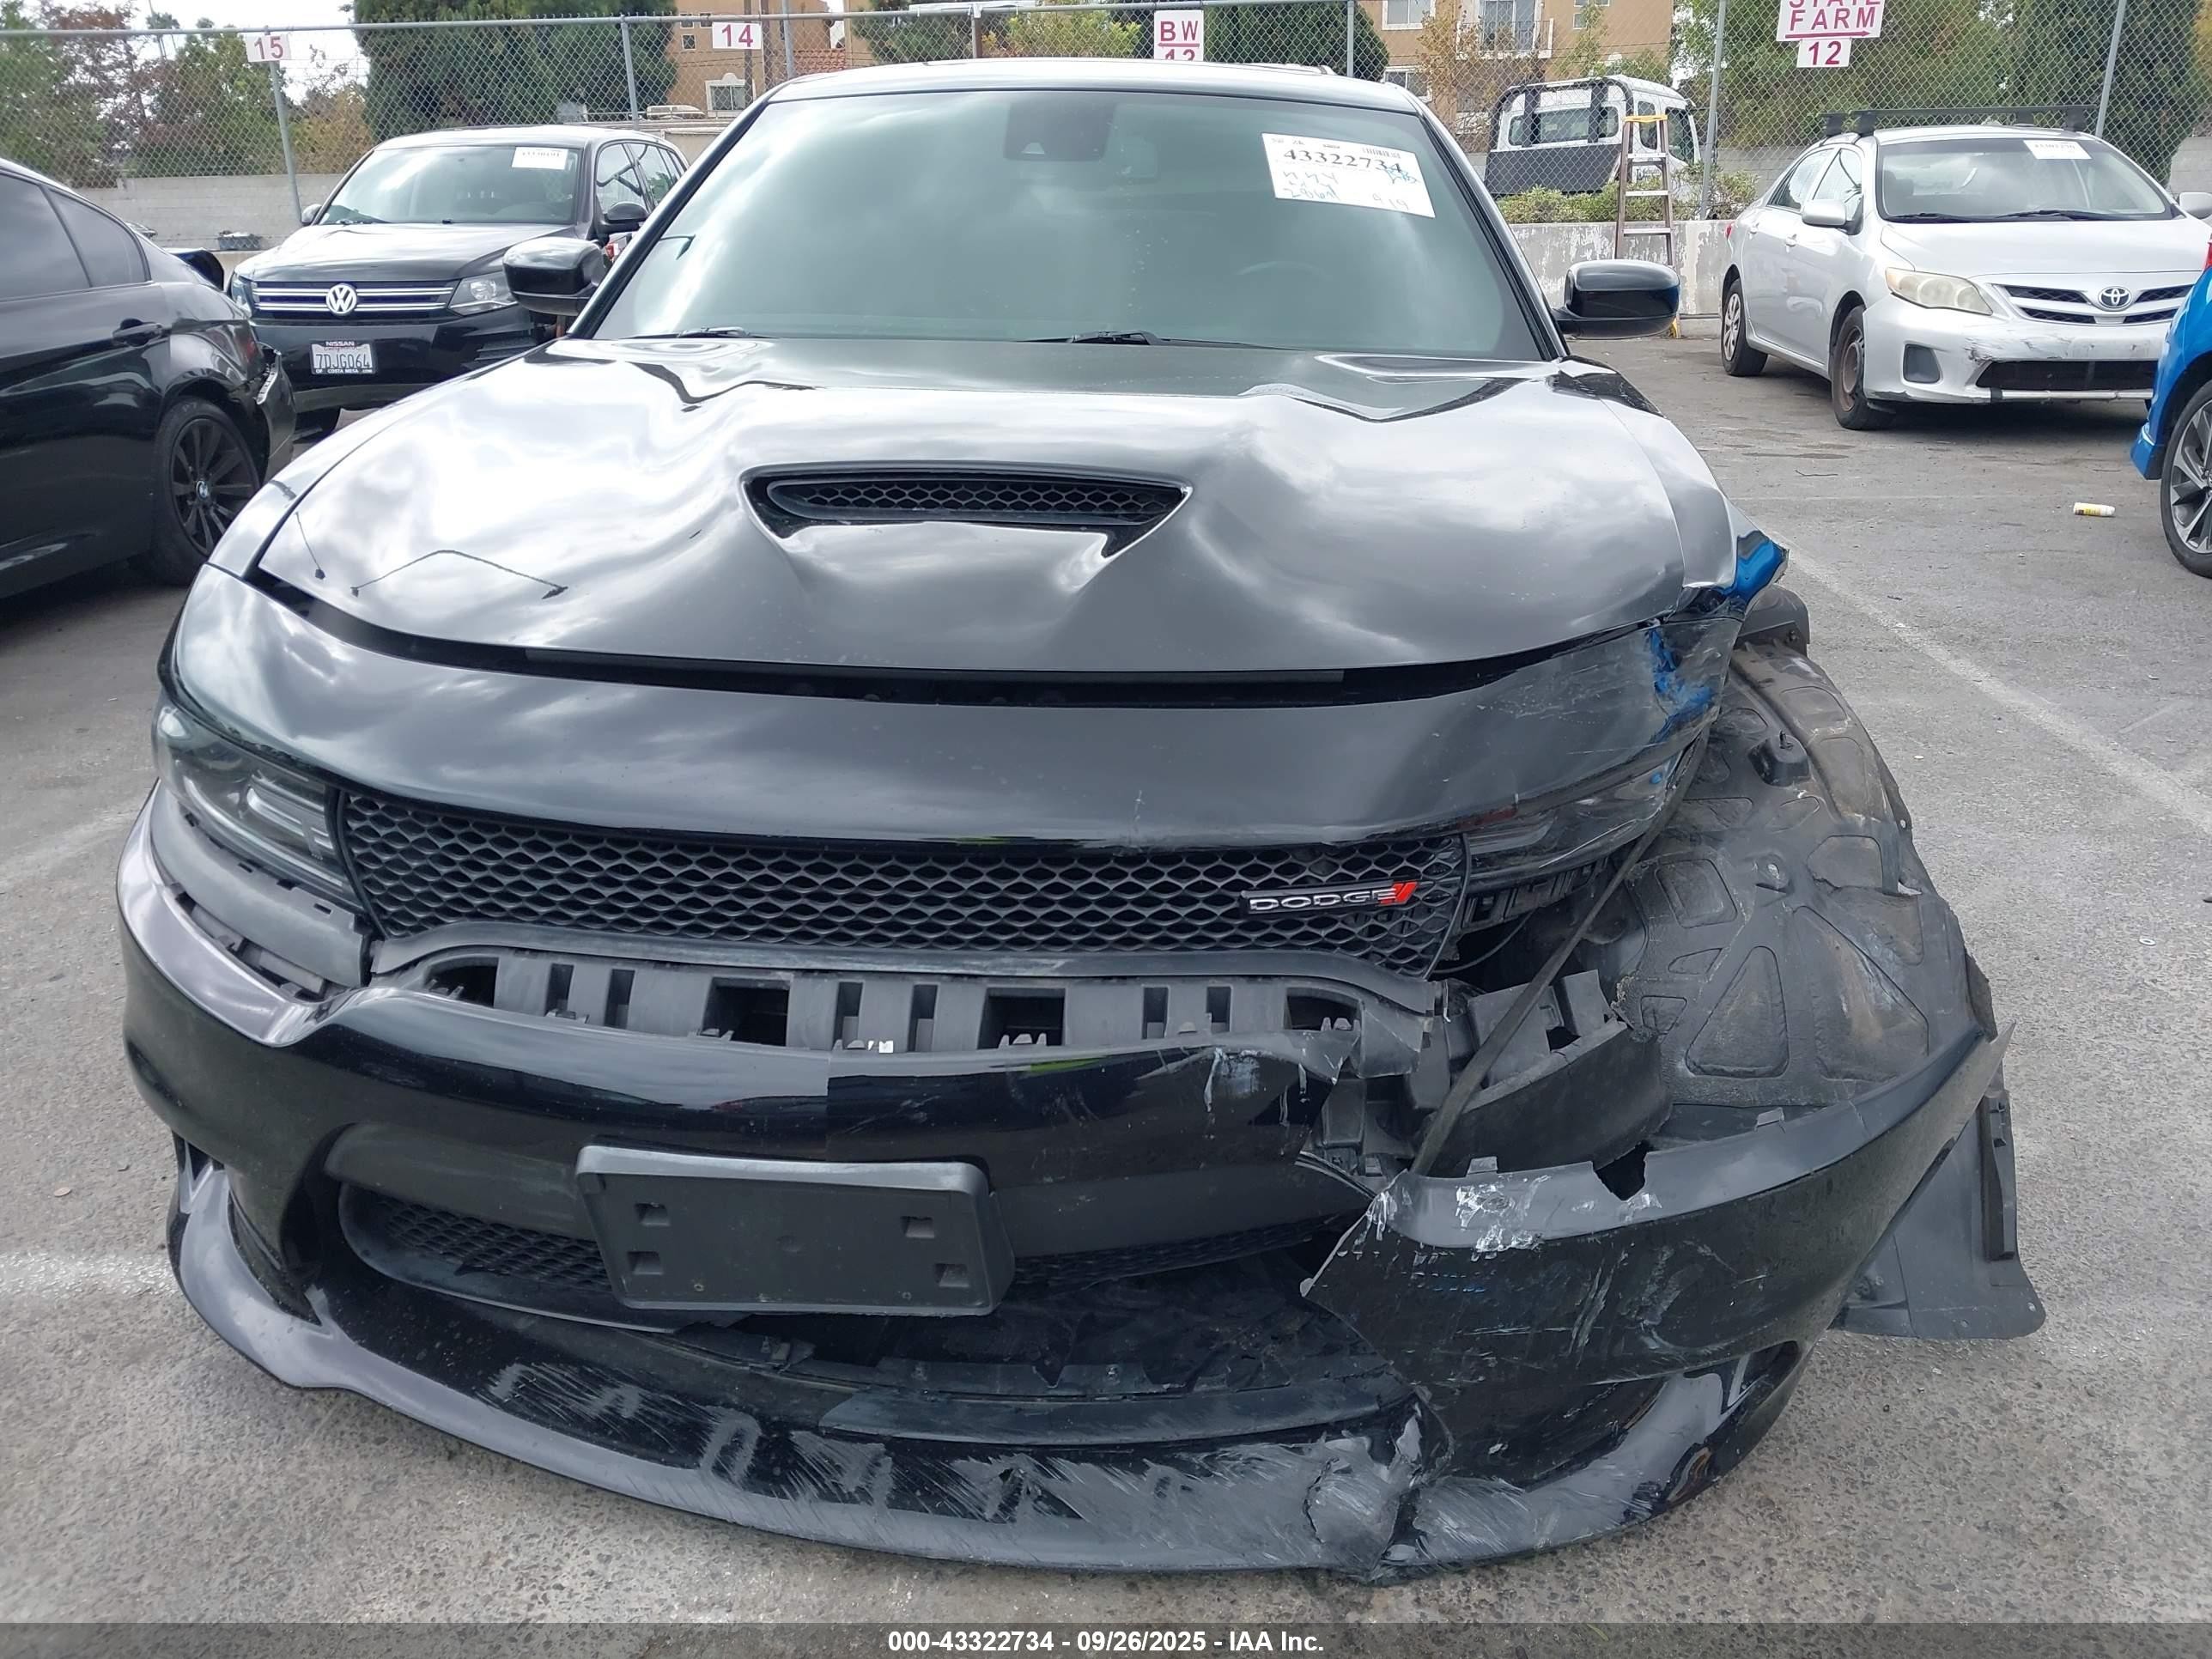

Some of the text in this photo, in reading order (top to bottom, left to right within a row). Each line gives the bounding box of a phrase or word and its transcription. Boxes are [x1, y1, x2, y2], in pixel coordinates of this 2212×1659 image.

[1790, 7, 1876, 31] FARM
[721, 24, 753, 47] 14
[1160, 21, 1199, 41] BW
[254, 36, 283, 59] 15
[1808, 40, 1842, 65] 12
[1283, 149, 1402, 173] 43322734
[326, 283, 357, 314] VW
[1249, 888, 1397, 910] DODGE
